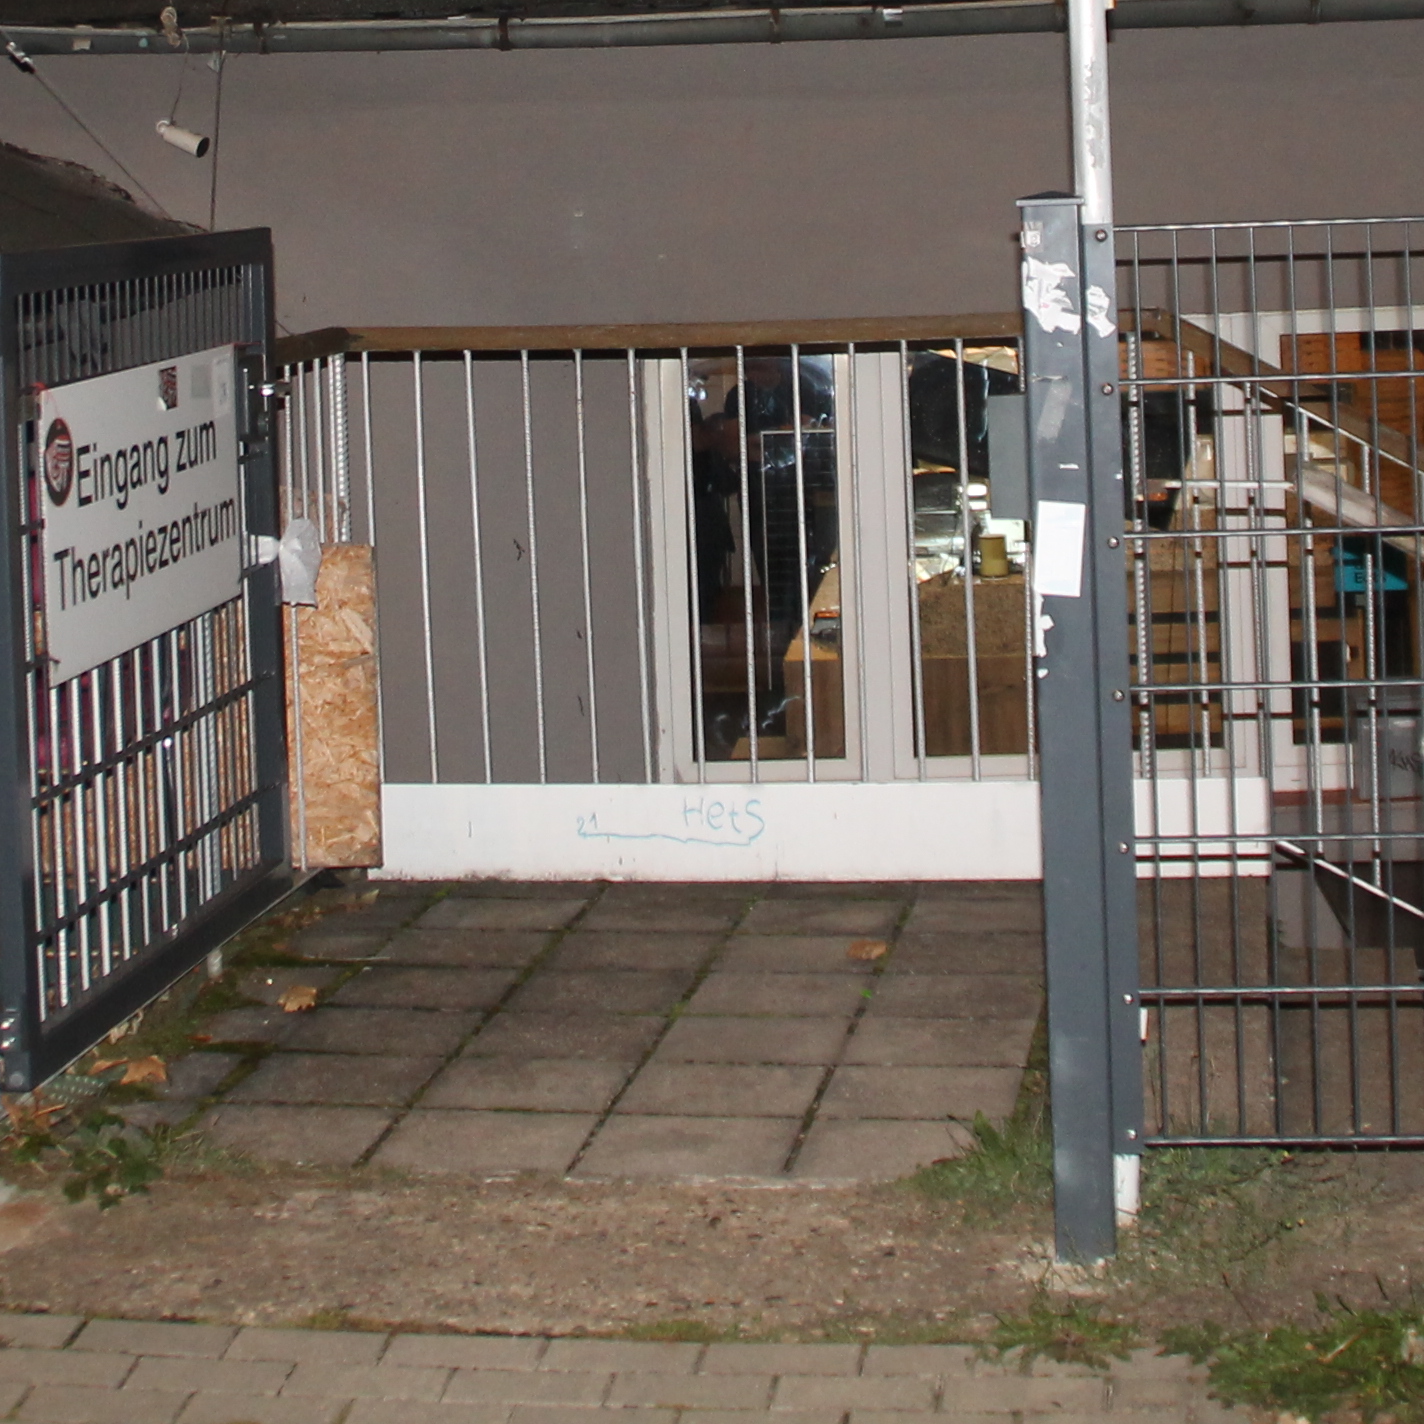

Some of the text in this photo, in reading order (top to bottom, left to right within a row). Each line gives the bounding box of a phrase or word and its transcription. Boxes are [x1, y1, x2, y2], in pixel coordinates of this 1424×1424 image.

[76, 420, 217, 510] Eingang zum
[53, 496, 237, 612] Therapiezentrum
